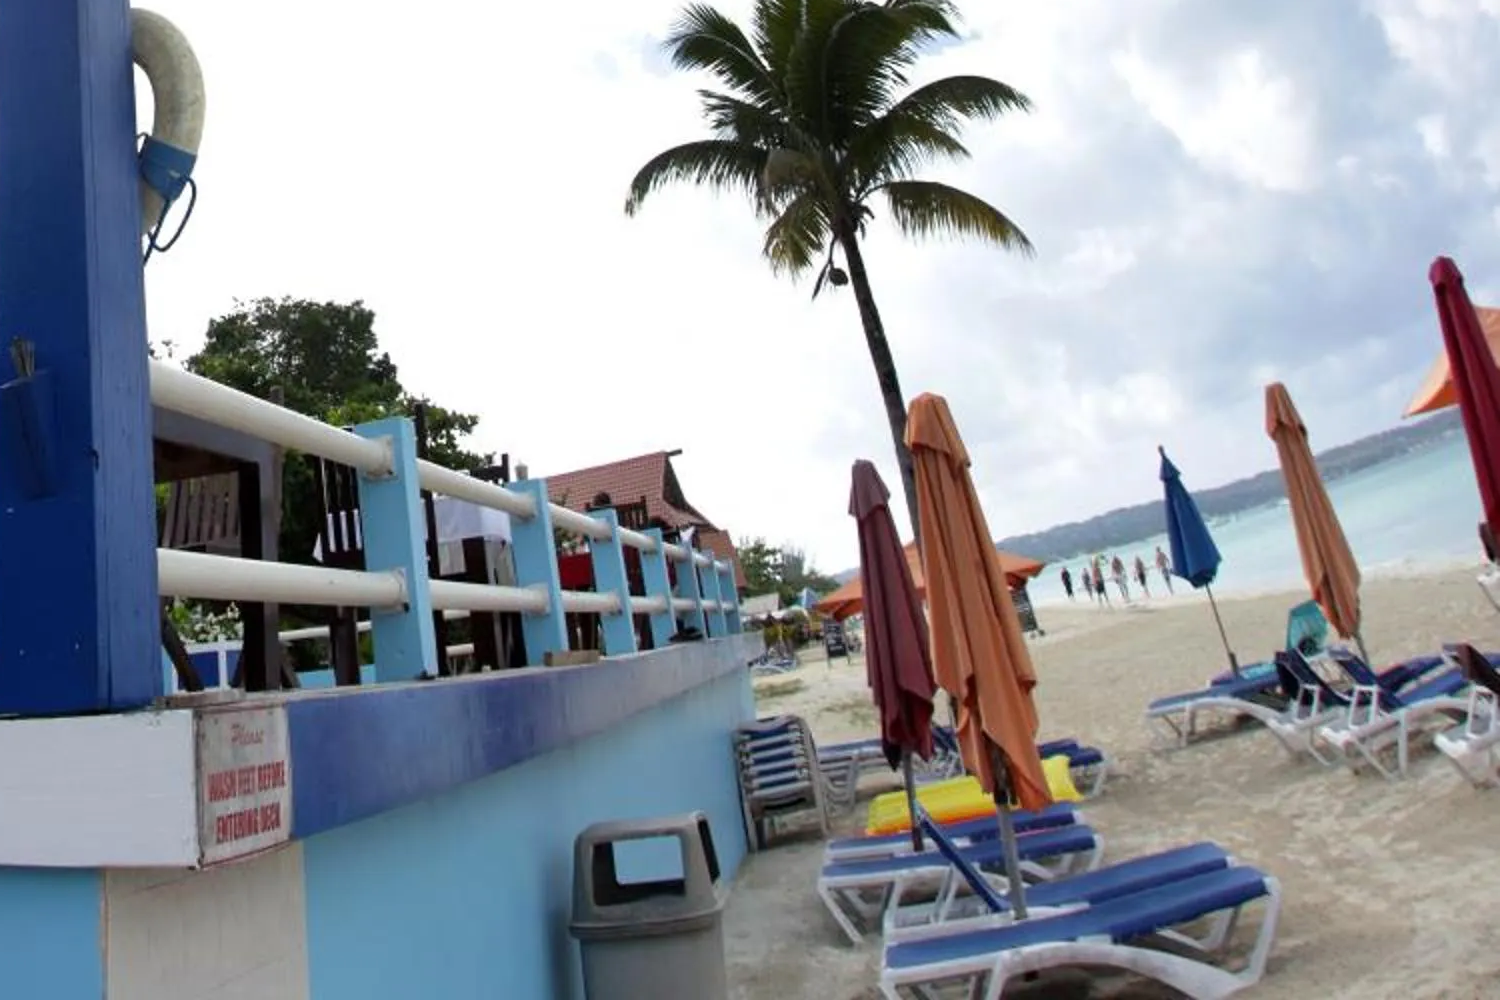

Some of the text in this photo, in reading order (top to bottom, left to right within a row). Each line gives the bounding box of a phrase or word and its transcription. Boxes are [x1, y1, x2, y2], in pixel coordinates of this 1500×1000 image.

[208, 760, 286, 803] WASH FEET BEFORE
[216, 807, 258, 844] ENTERING
